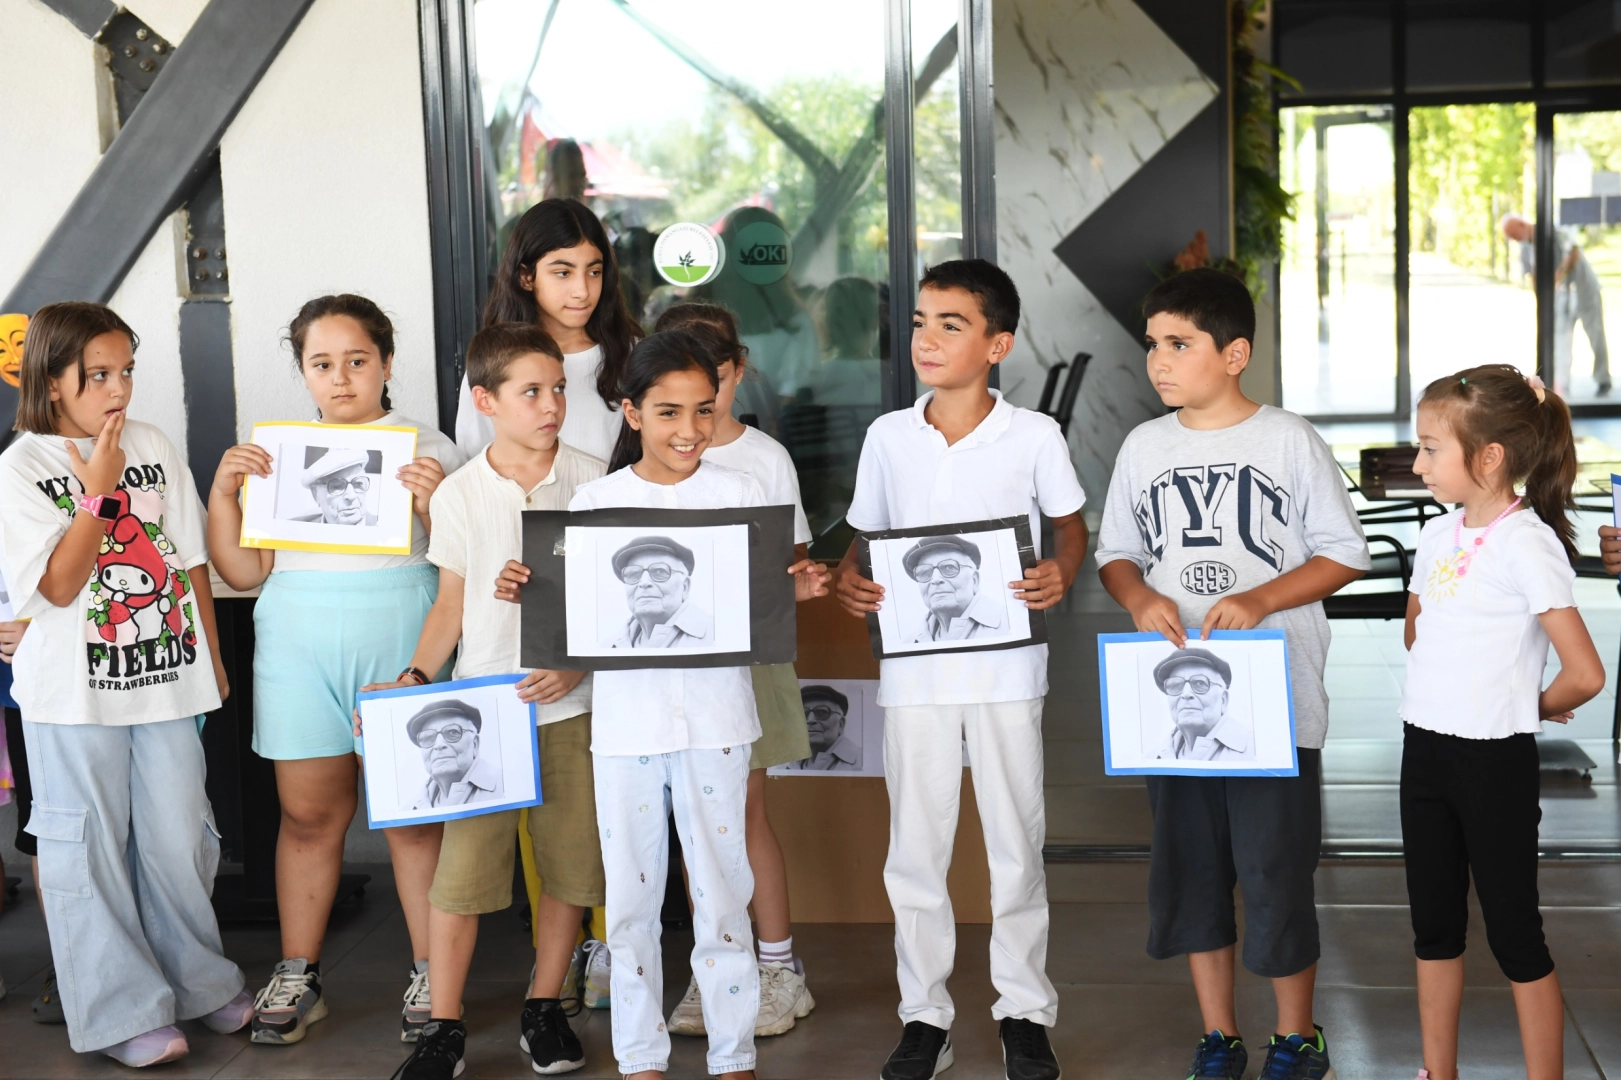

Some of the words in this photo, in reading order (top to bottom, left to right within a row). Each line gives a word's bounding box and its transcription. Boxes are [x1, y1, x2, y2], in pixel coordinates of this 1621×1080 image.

[1135, 463, 1290, 577] NYC
[1185, 563, 1231, 593] 1993
[87, 631, 197, 678] FIELDS
[88, 678, 97, 689] OF
[98, 671, 179, 691] STRAWBERRIES
